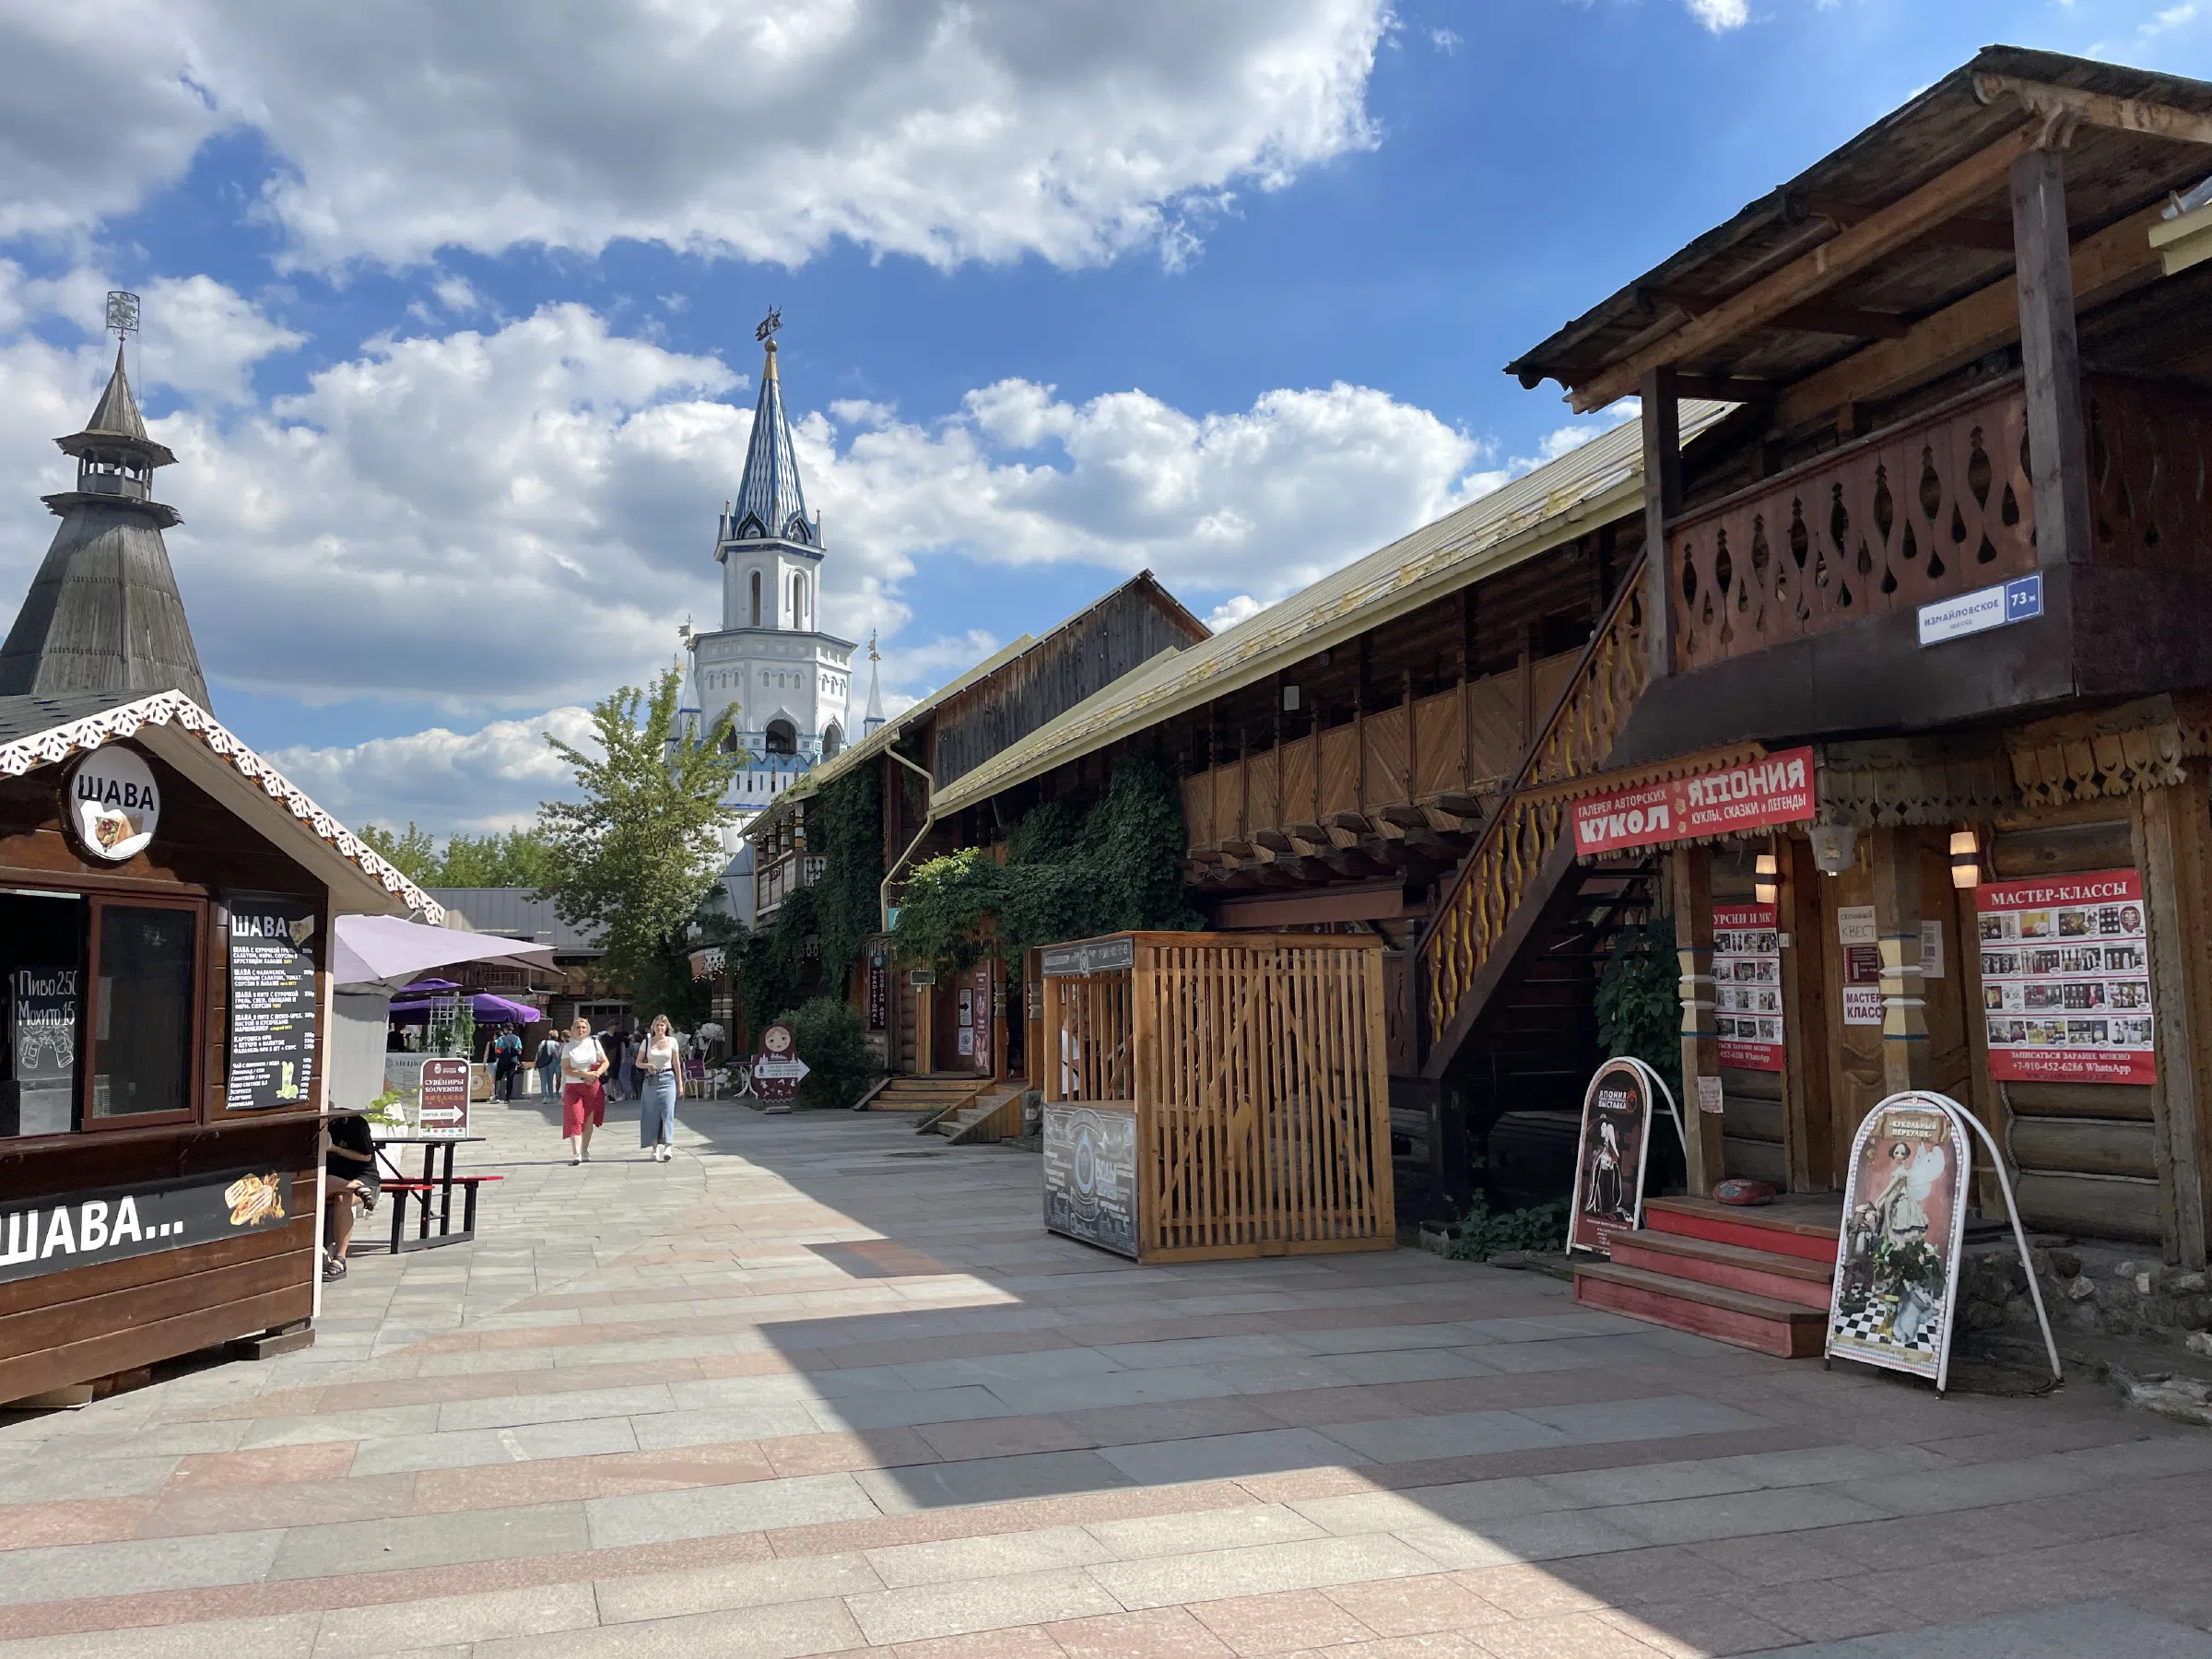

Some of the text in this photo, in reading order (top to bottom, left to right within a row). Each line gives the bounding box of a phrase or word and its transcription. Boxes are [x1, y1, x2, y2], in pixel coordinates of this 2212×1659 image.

[1924, 599, 1999, 627] ИЗМАЙЛОВСКОЕ
[77, 774, 155, 812] ШАВА
[1688, 758, 1806, 807] ЯПОНИЯ
[1578, 789, 1667, 818] ГАЛЕРЕЯ АВТОРСКИХ
[1691, 811, 1722, 825] КУКЛЫ,
[1724, 801, 1759, 820] СКАЗКИ
[1767, 793, 1806, 814] ЛЕГЕНДЫ
[1579, 805, 1669, 843] КУКОЛ
[1991, 881, 2127, 906] МАСТЕР-КЛАССЫ
[232, 915, 288, 937] ШАВА
[1749, 913, 1757, 924] И
[1841, 925, 1877, 938] КВЕСТ
[19, 971, 55, 995] Пиво
[1847, 1006, 1881, 1018] КЛАСС
[2011, 1052, 2061, 1060] ЗАПИСАТЬСЯ
[2100, 1053, 2130, 1061] МОЖНО
[2013, 1062, 2131, 1075] +7-910-452-6286 WhatsApp
[1598, 1100, 1626, 1109] ВЫСТАВКА
[1599, 1090, 1627, 1099] ЯПОНИЯ
[0, 1195, 183, 1266] ШАВА...
